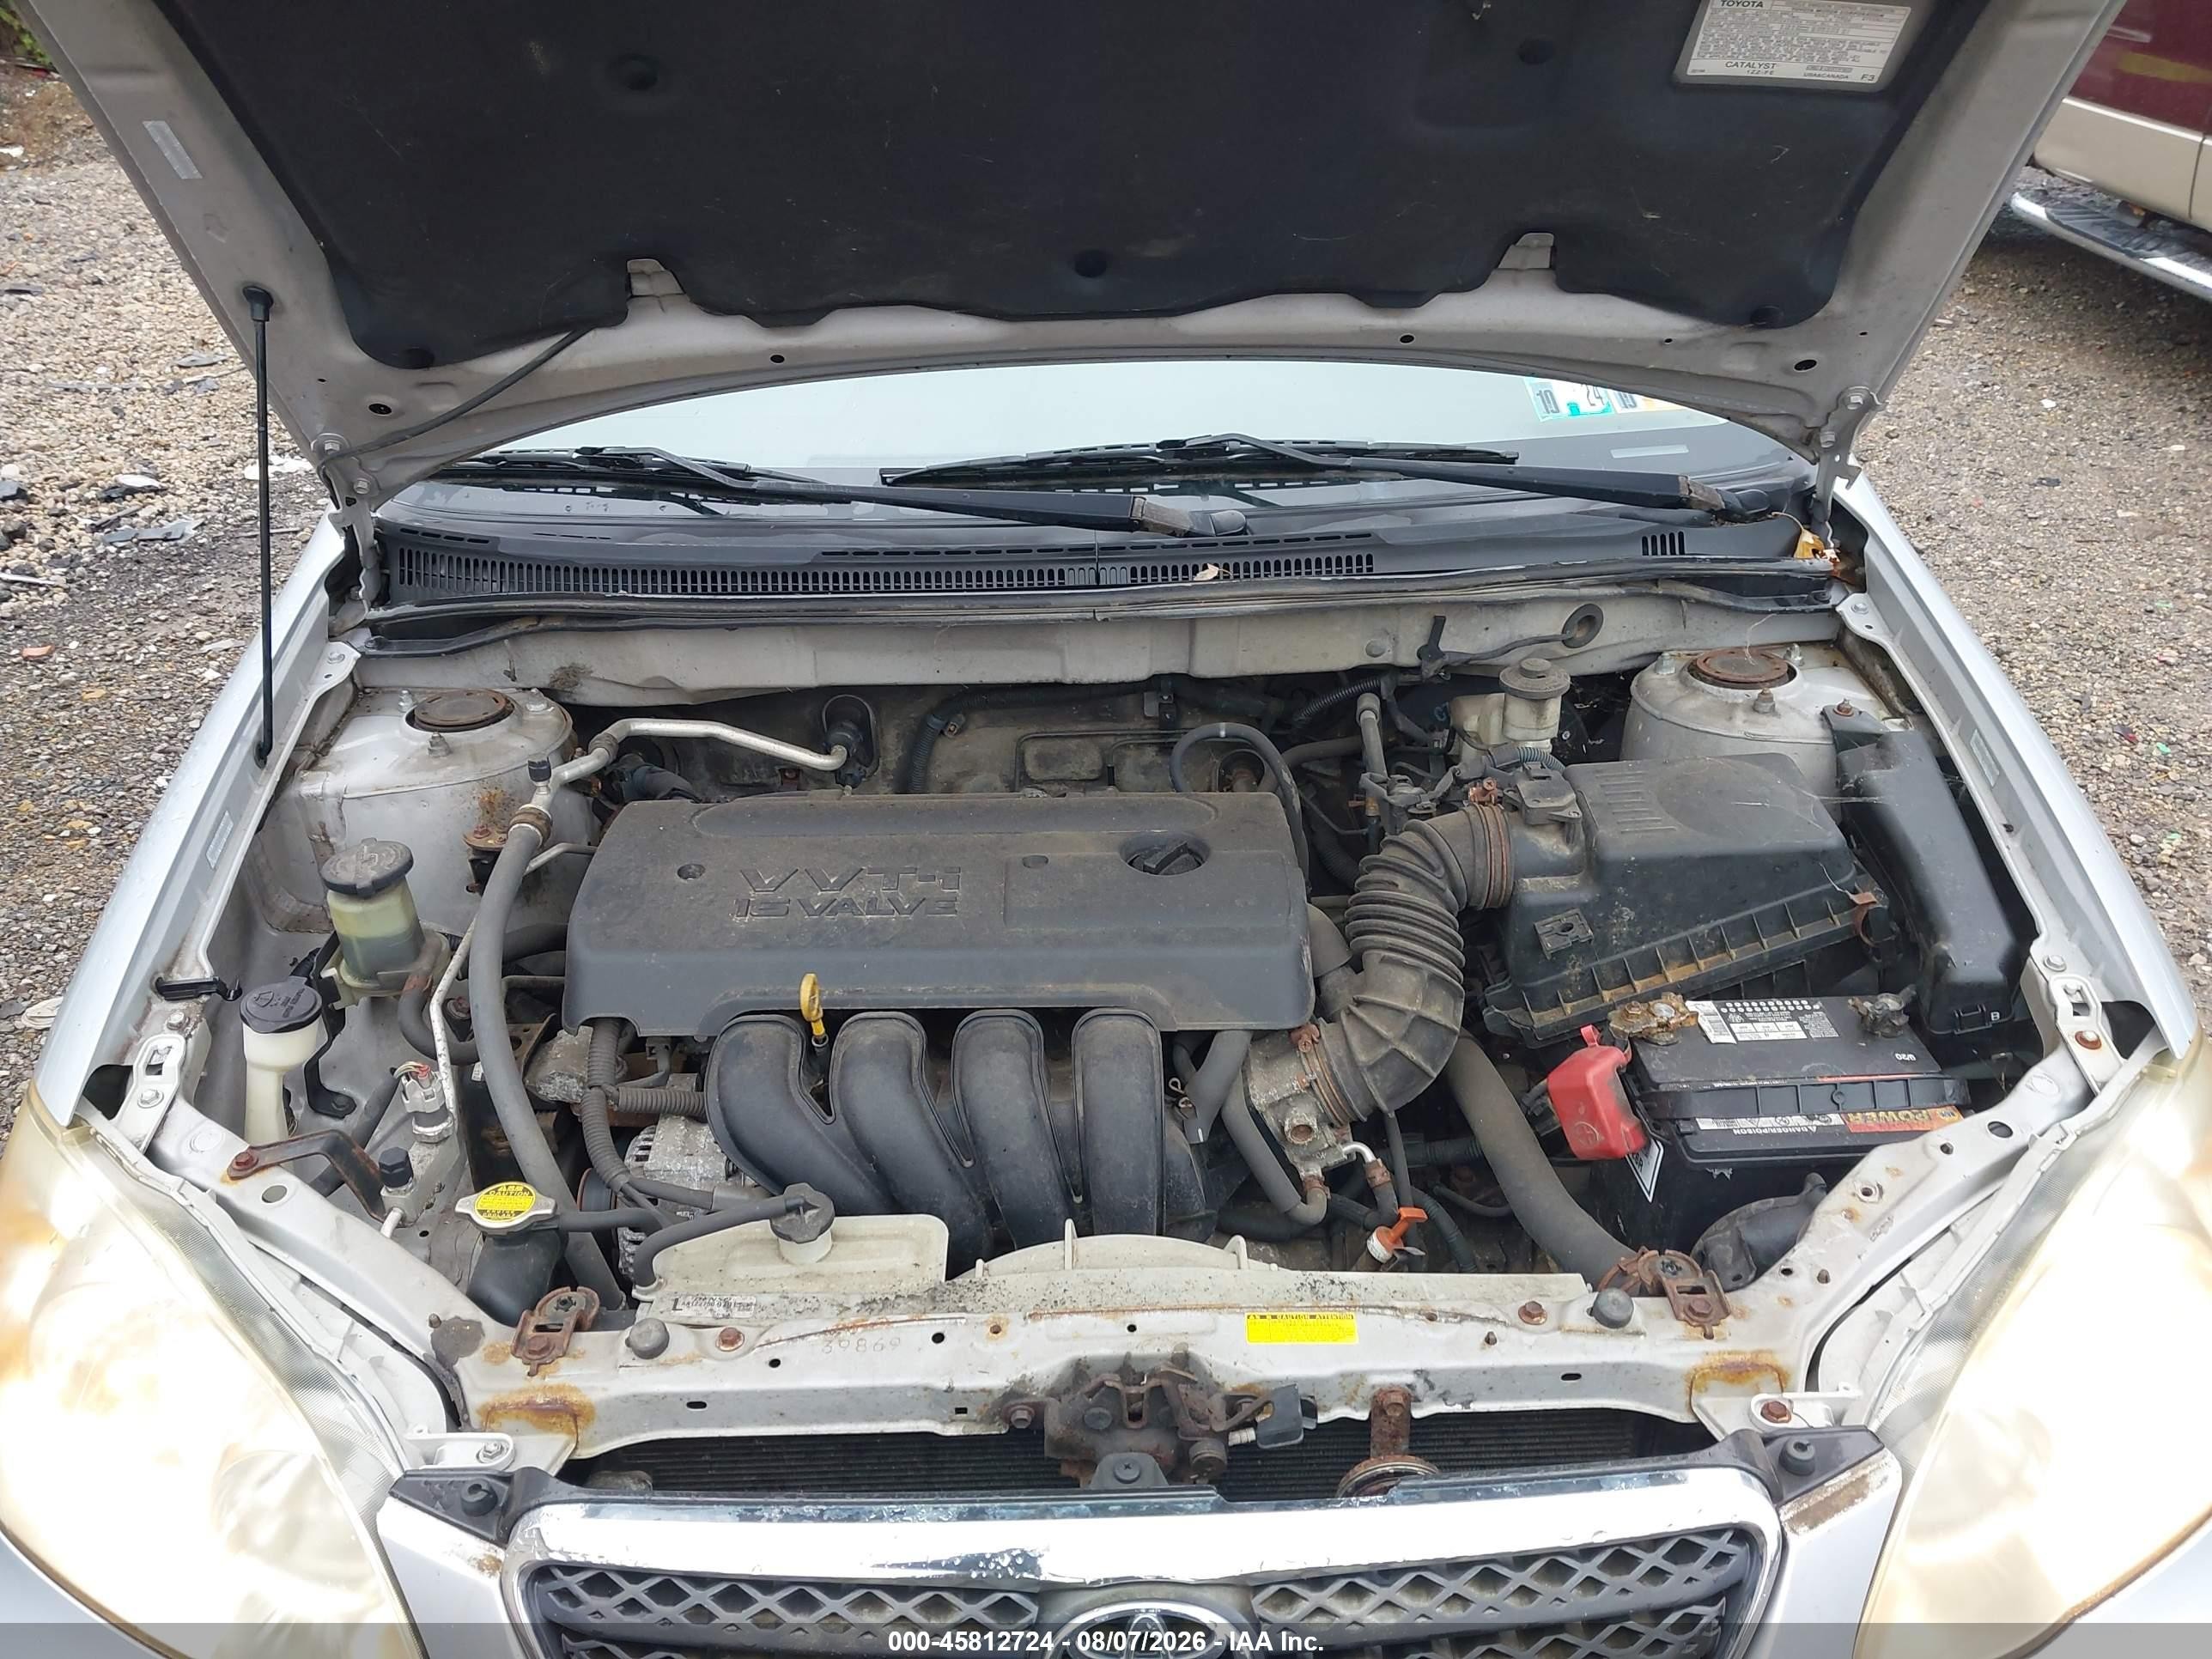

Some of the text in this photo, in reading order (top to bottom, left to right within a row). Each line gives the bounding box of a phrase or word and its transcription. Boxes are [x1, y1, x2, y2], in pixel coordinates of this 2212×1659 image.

[1725, 61, 1777, 70] CATALYST
[734, 896, 958, 918] 16 VALVE
[1990, 1011, 2000, 1021] B
[1847, 1109, 1931, 1125] POWER
[1732, 1126, 1810, 1136] DANGER/POISON
[672, 1297, 684, 1311] L
